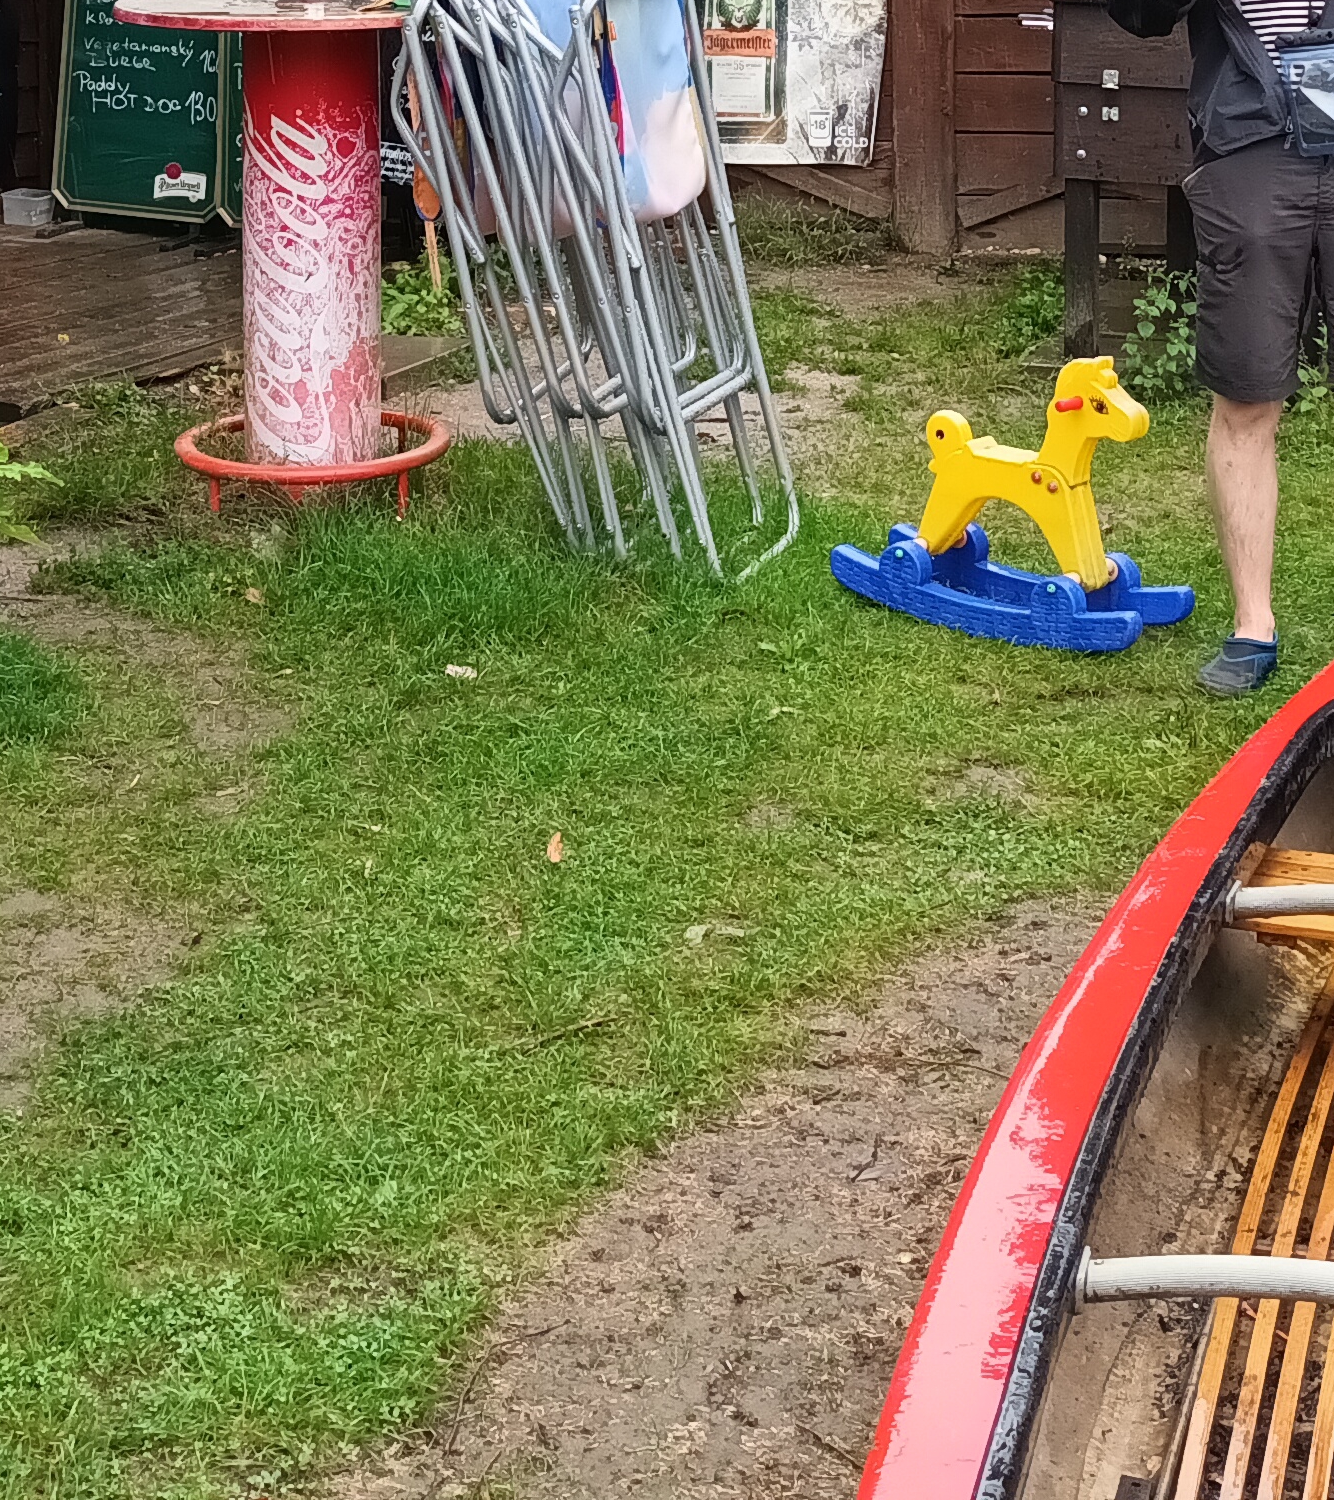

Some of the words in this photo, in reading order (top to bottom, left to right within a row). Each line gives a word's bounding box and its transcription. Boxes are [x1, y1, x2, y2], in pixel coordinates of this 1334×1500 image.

[706, 34, 773, 52] Jägermeister
[73, 70, 130, 96] Paddy
[835, 126, 855, 136] ICE
[834, 137, 869, 148] COLD
